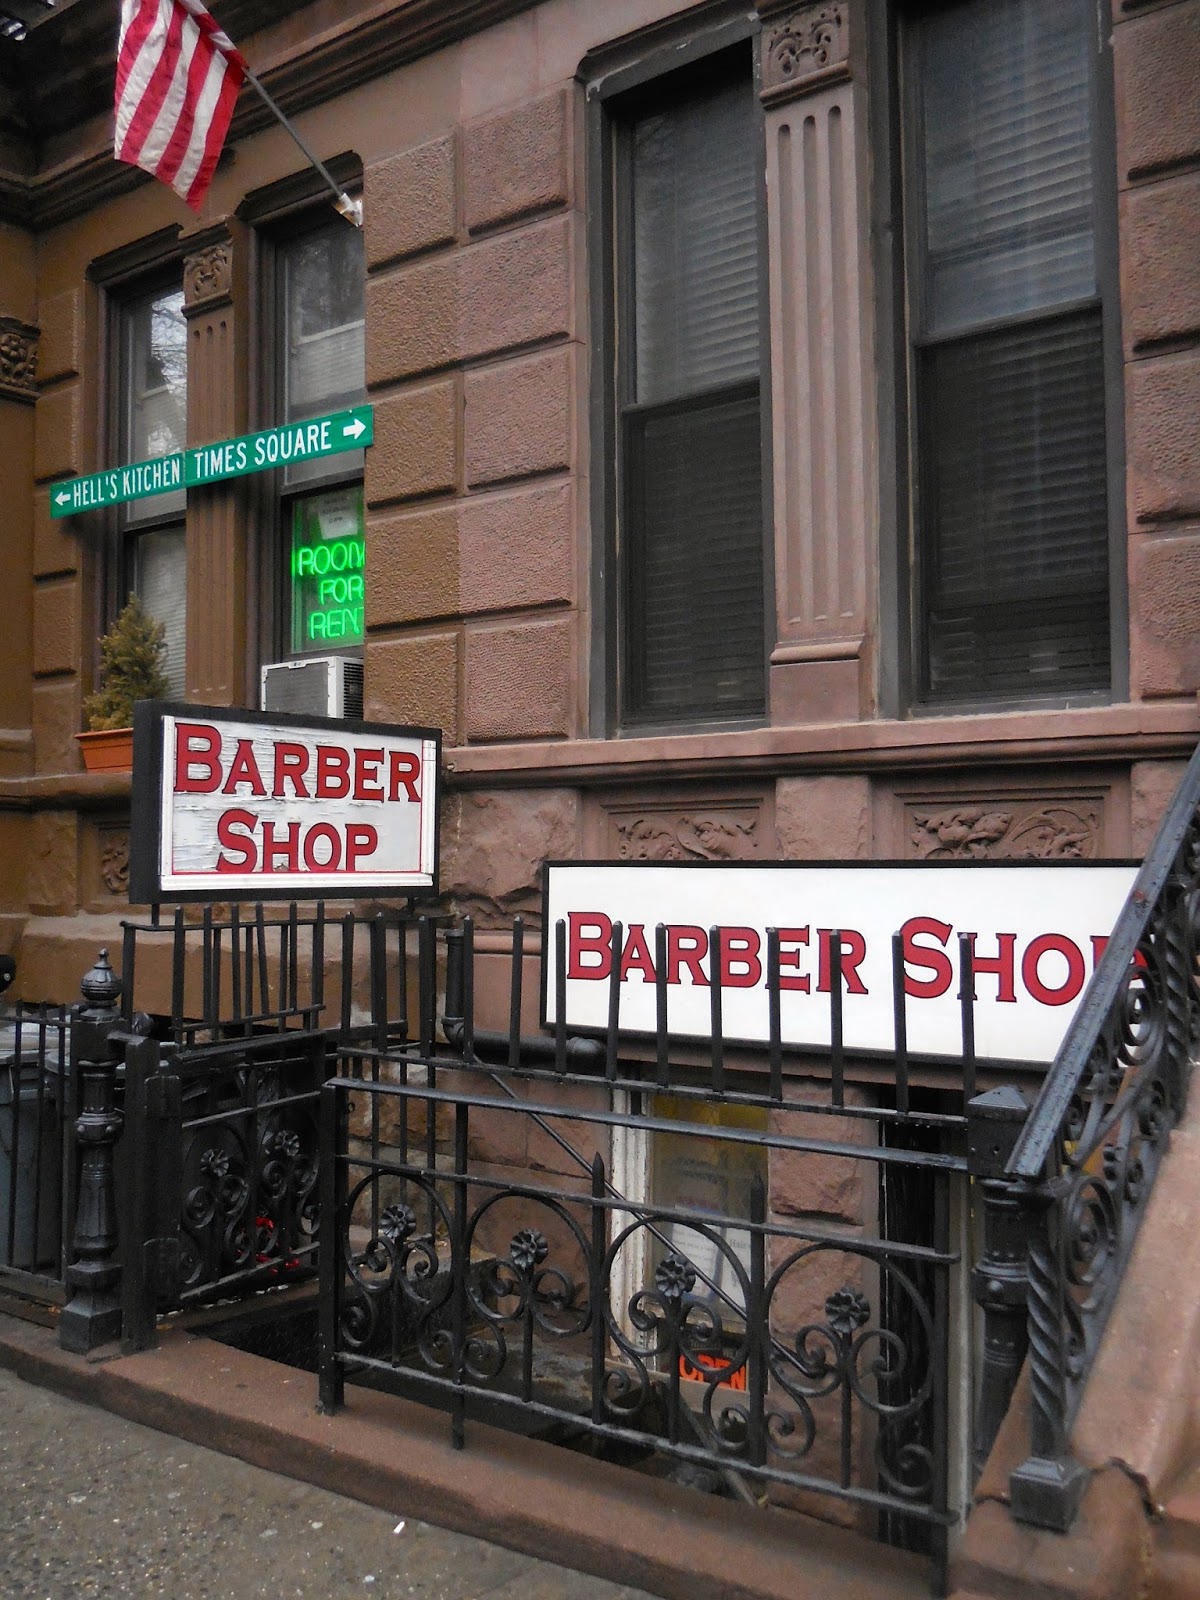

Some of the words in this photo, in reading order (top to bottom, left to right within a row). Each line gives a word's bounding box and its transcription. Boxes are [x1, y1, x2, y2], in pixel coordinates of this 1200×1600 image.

[194, 443, 247, 479] TIMES
[255, 420, 332, 465] SQUARE
[73, 472, 118, 507] HELL'S
[123, 458, 180, 496] KITCHEN
[320, 576, 363, 605] FOR
[174, 722, 422, 803] BARBER
[216, 808, 378, 874] SHOP
[566, 911, 869, 994] BARBER
